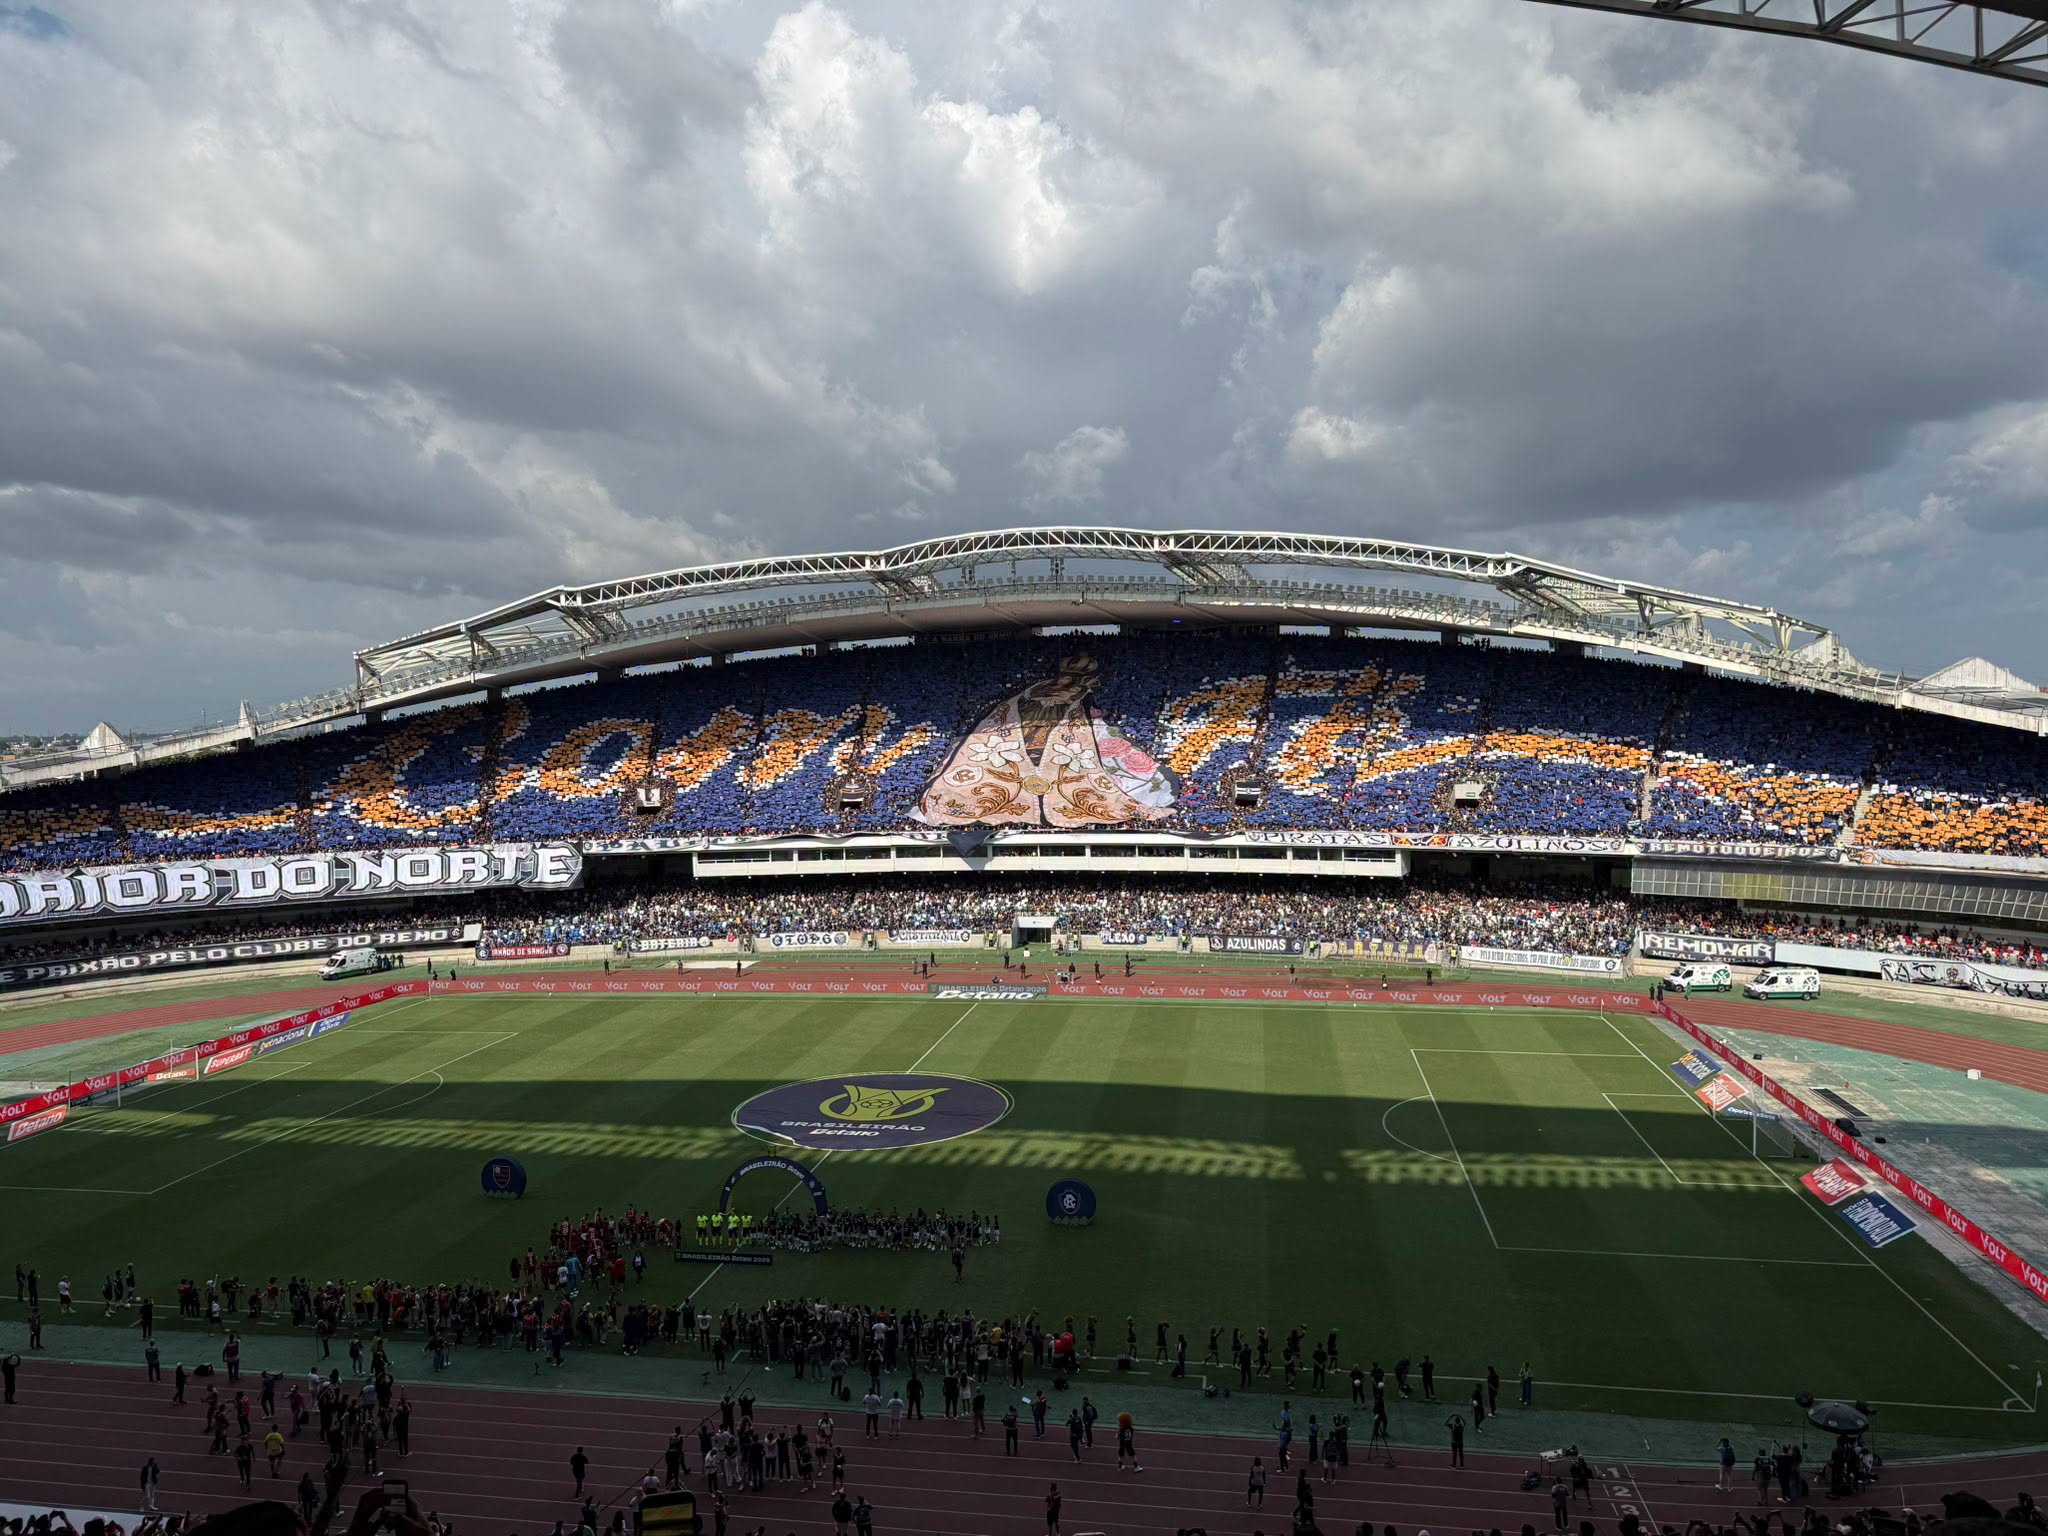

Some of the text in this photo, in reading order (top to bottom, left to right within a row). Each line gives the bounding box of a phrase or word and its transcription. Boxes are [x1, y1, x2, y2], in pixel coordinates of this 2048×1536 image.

[1263, 831, 1609, 852] PIRATAS AZULINOS
[229, 859, 328, 901] DO
[351, 846, 579, 890] NORTE
[1227, 937, 1287, 951] AZULINDAS
[1645, 934, 1773, 958] REMOWAR
[26, 956, 140, 981] PAIXÃO
[149, 948, 226, 967] PELO
[234, 937, 327, 958] CLUBE
[337, 934, 375, 948] DO
[379, 930, 448, 945] REMO
[1652, 950, 1696, 960] METAL
[392, 983, 414, 993] VOLT
[429, 981, 450, 990] VOLT
[463, 981, 485, 990] VOLT
[498, 981, 520, 990] VOLT
[533, 981, 556, 990] VOLT
[569, 981, 592, 990] VOLT
[605, 981, 628, 990] VOLT
[642, 981, 664, 990] VOLT
[678, 981, 701, 990] VOLT
[715, 981, 738, 990] VOLT
[752, 982, 775, 990] VOLT
[788, 982, 812, 991] VOLT
[826, 982, 849, 991] VOLT
[863, 982, 887, 991] VOLT
[901, 982, 925, 991] VOLT
[1061, 984, 1086, 993] VOLT
[1100, 985, 1125, 995] VOLT
[1140, 986, 1164, 995] VOLT
[369, 991, 384, 1001] VOLT
[936, 990, 1034, 1000] Betano
[1180, 987, 1205, 996] VOLT
[1221, 987, 1247, 997] VOLT
[1262, 988, 1288, 998] VOLT
[1304, 989, 1331, 999] VOLT
[1347, 990, 1374, 1000] VOLT
[1390, 991, 1417, 1001] VOLT
[1434, 992, 1461, 1002] VOLT
[1478, 993, 1505, 1003] VOLT
[1523, 994, 1550, 1004] VOLT
[1568, 994, 1596, 1004] VOLT
[1613, 995, 1640, 1006] VOLT
[318, 1006, 335, 1017] VOLT
[291, 1013, 309, 1026] VOLT
[261, 1023, 280, 1035] VOLT
[230, 1032, 250, 1045] VOLT
[259, 1027, 307, 1052] betnacional
[198, 1041, 218, 1054] VOLT
[162, 1053, 185, 1067] VOLT
[126, 1064, 149, 1078] VOLT
[156, 1070, 187, 1081] Betano
[1744, 1062, 1757, 1079] VOLT
[86, 1075, 111, 1092] VOLT
[43, 1089, 70, 1104] VOLT
[1782, 1089, 1796, 1108] VOLT
[0, 1102, 26, 1120] VOLT
[1803, 1106, 1818, 1125] VOLT
[16, 1111, 62, 1138] Betano
[780, 1120, 926, 1132] BRASILEIRÃO
[809, 1128, 880, 1138] Betano
[1827, 1121, 1844, 1144] VOLT
[1852, 1140, 1870, 1162] VOLT
[739, 1160, 787, 1177] BRASILEIRÃO
[1879, 1161, 1900, 1183] VOLT
[1812, 1163, 1860, 1197] SUPERBET
[1911, 1181, 1933, 1208] VOLT
[1944, 1205, 1967, 1233] VOLT
[1981, 1233, 2006, 1263] VOLT
[2021, 1262, 2048, 1295] VOLT
[1606, 1467, 1621, 1478] 1
[1612, 1486, 1632, 1497] 2
[1620, 1504, 1640, 1516] 3
